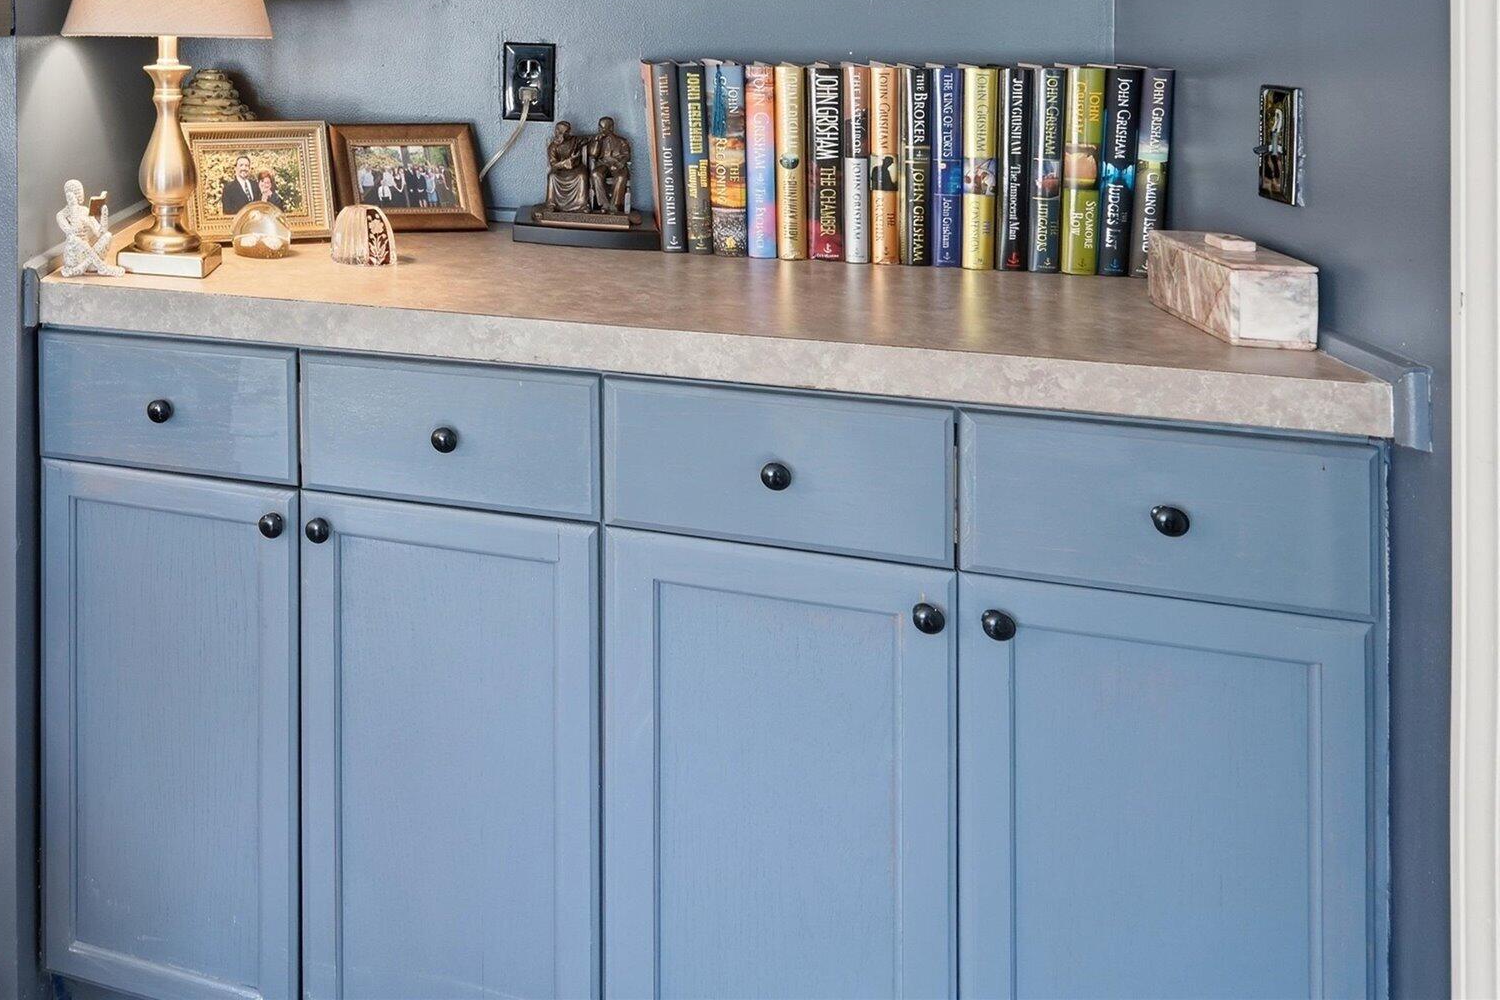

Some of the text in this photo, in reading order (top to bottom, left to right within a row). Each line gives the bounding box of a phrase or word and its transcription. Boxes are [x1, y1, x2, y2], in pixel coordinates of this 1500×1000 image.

[727, 86, 740, 114] JOHN
[752, 73, 768, 107] JOHN
[853, 73, 861, 94] THE
[878, 72, 891, 149] JOHN GRISHAM
[914, 73, 928, 143] THE BROKER
[1075, 82, 1086, 133] GRISHAM
[1089, 91, 1100, 122] JOHN
[686, 73, 703, 154] JOHN GRISHAM
[815, 74, 839, 160] JOHN GRISHAM
[943, 73, 953, 158] THE KING OF TORTS
[976, 72, 989, 152] JOHN GRISHAM
[1044, 74, 1060, 155] JOHN GRISHAM
[1114, 77, 1133, 159] JOHN GRISHAM
[1150, 77, 1167, 154] JOHN GRISHAM
[658, 75, 676, 225] THE APPEAL JOHN GRISHAM
[753, 112, 769, 169] GRISHAM
[1009, 78, 1023, 240] JOHN GRISHAM The Innocent Man
[688, 165, 698, 198] Lawyer
[698, 159, 708, 188] Rogue
[715, 137, 727, 205] RECKONING
[729, 162, 739, 182] THE
[755, 188, 764, 203] THE
[820, 166, 836, 186] THE
[1144, 171, 1159, 215] CAMINO
[819, 188, 836, 237] CHAMBER
[852, 163, 862, 240] JOHN GRISHAM
[912, 168, 925, 262] JOHN GRISHAM
[940, 198, 952, 248] John Grisham
[1036, 203, 1049, 252] LITIGATORS
[1070, 211, 1082, 236] ROW
[1084, 200, 1097, 249] SYCAMORE
[1105, 183, 1125, 250] JUDGE'S LIST
